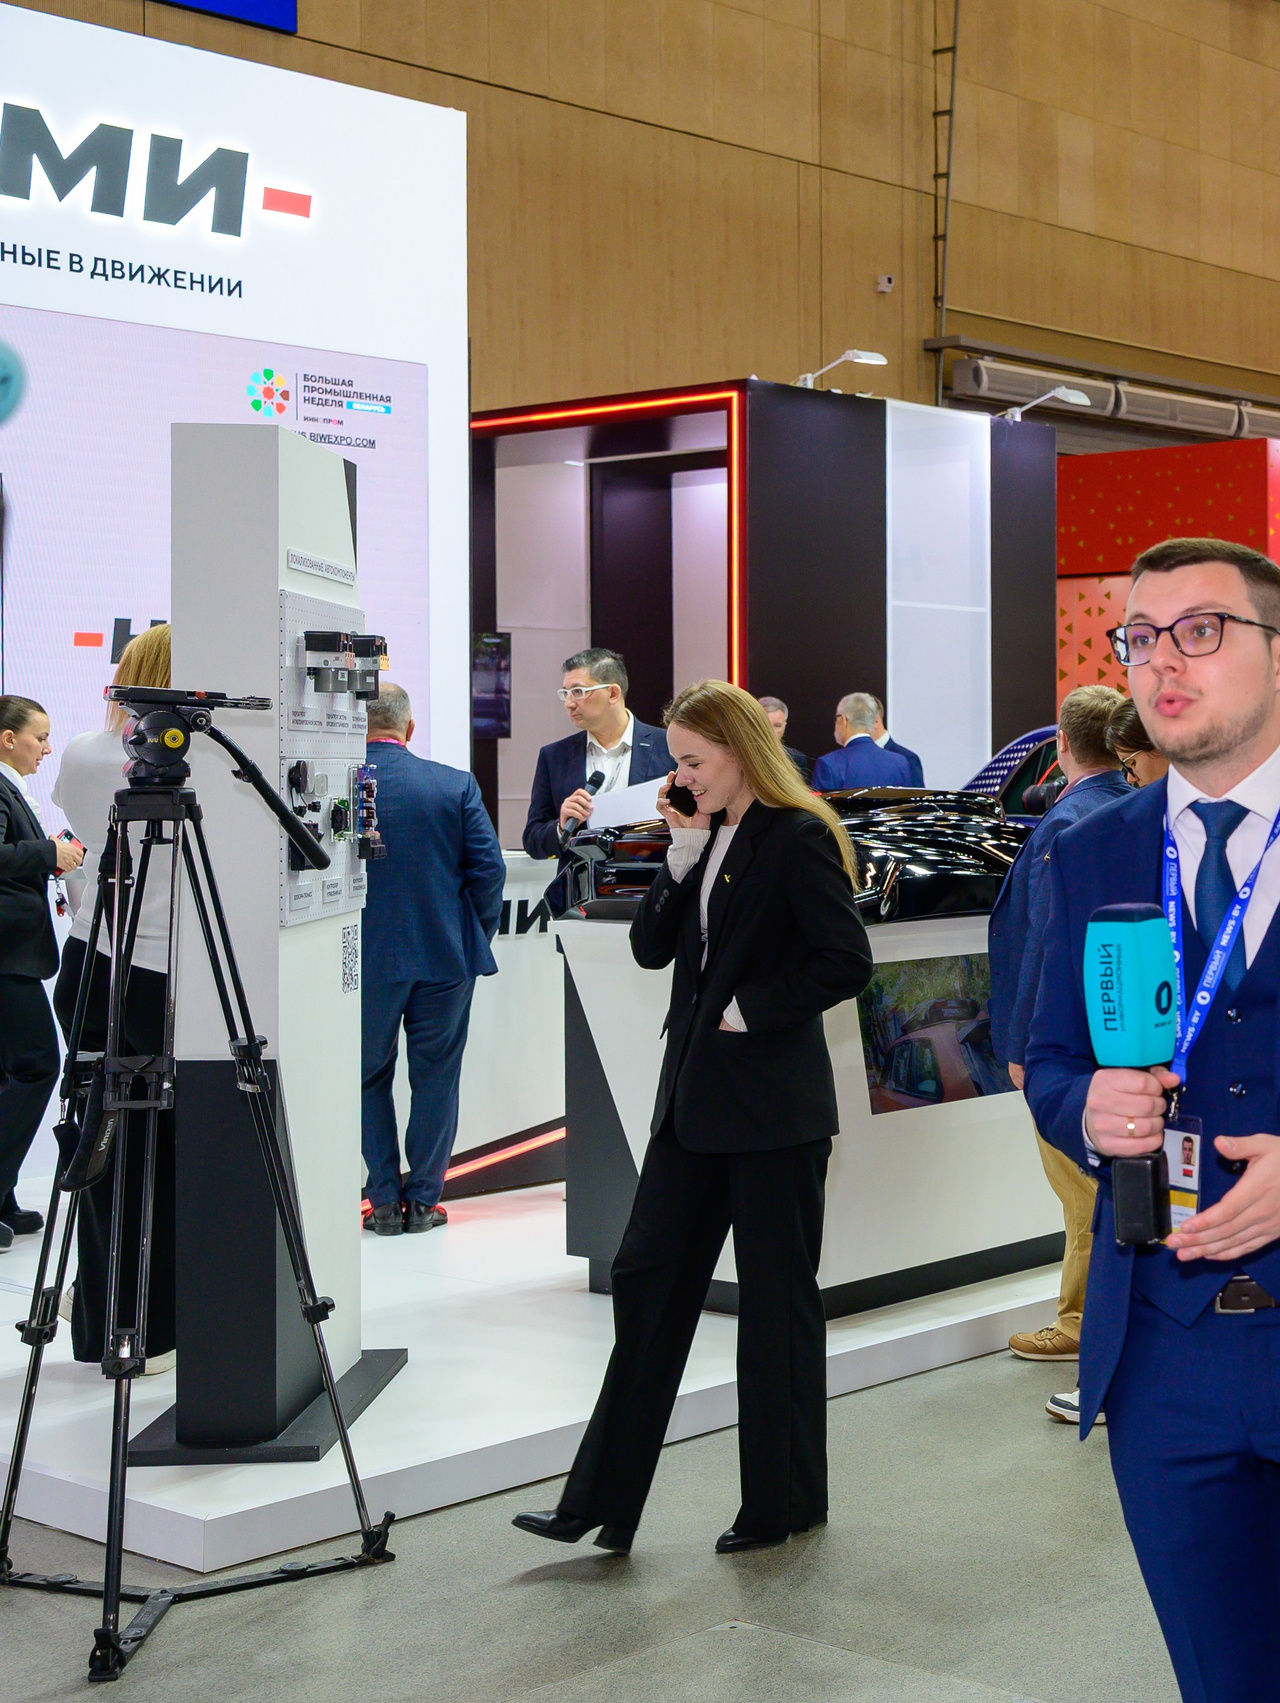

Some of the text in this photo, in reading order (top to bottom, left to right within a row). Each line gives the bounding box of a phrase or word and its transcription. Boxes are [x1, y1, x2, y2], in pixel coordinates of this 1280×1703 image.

[0, 242, 243, 298] НЫЕ В ДВИЖЕНИИ
[303, 374, 354, 388] БОЛЬШАЯ
[303, 385, 392, 403] ПРОМЫШЛЕННАЯ
[303, 396, 386, 413] НЕДЕЛЯ БЕЛАРУСЬ
[1097, 943, 1118, 1031] ПЕРВЫЙ
